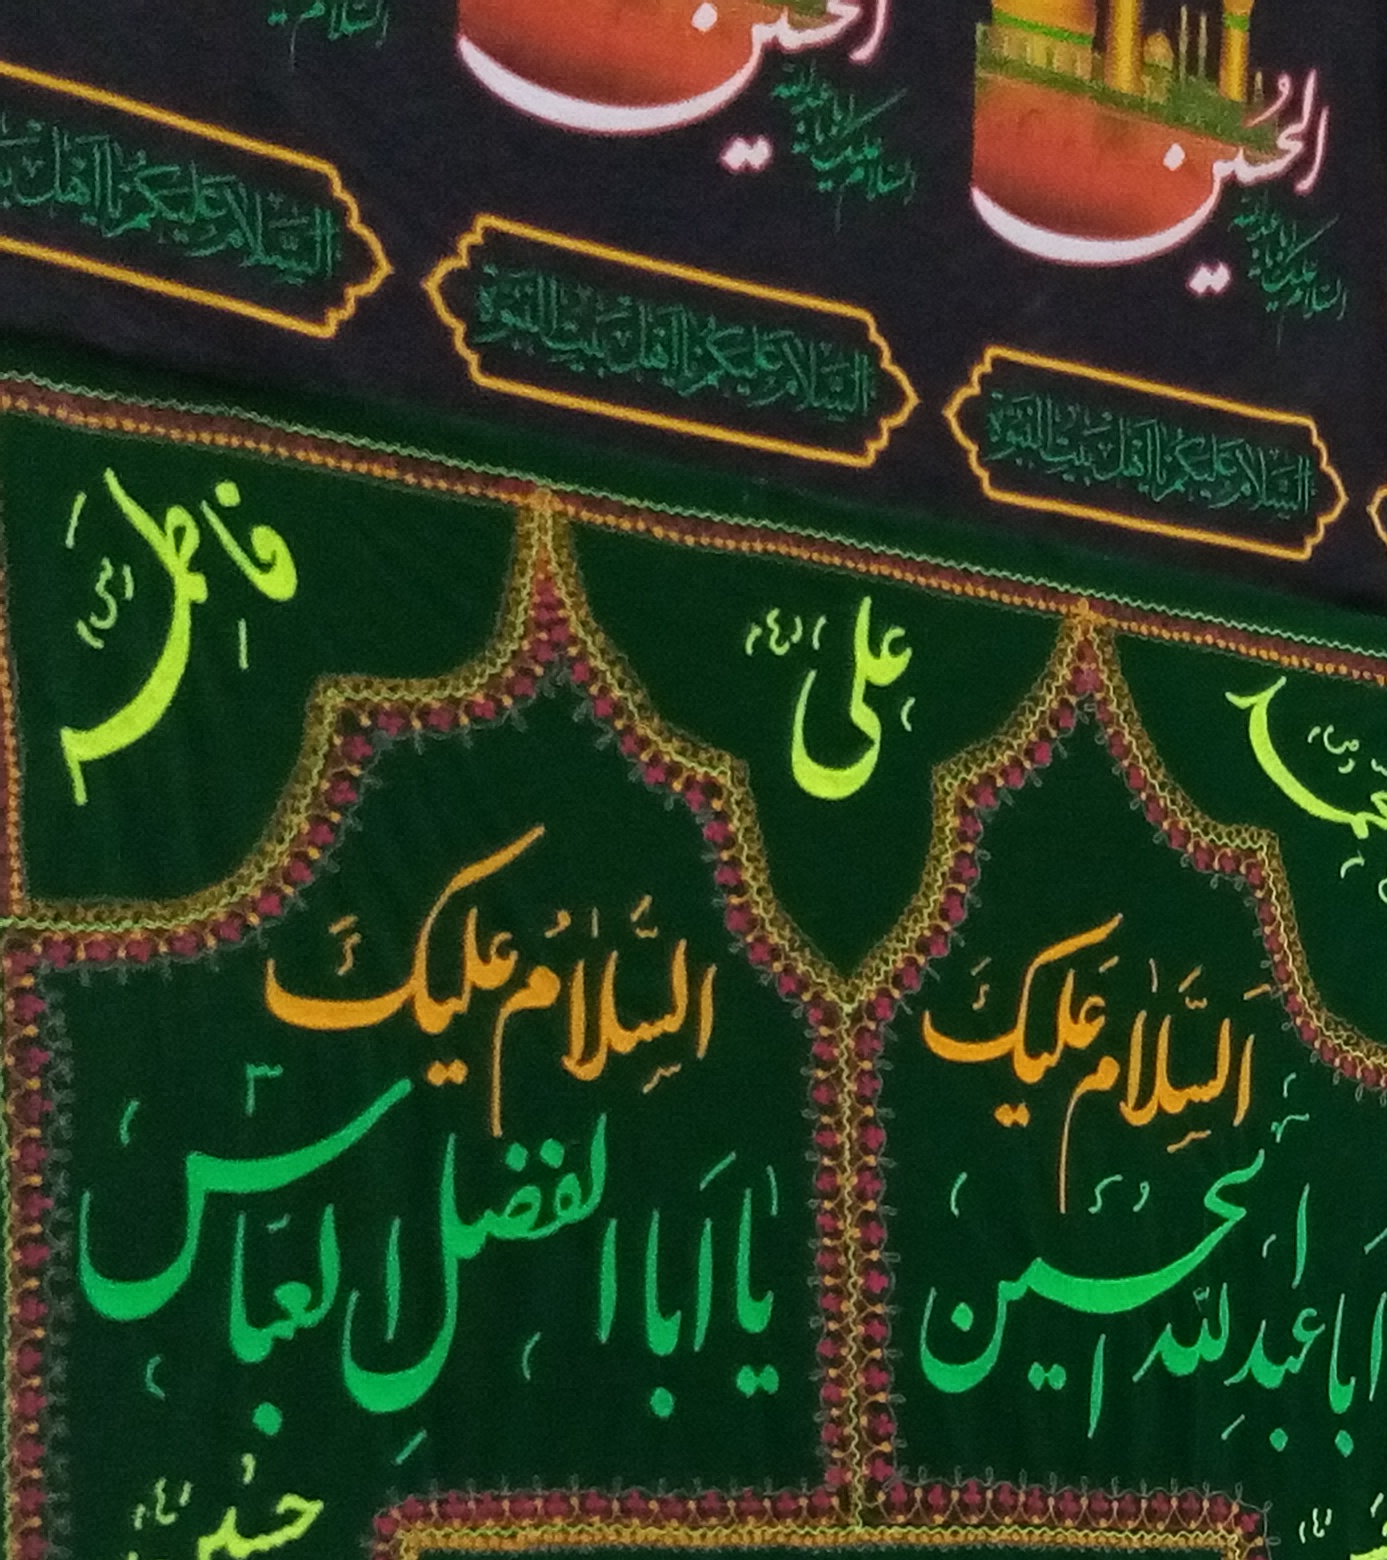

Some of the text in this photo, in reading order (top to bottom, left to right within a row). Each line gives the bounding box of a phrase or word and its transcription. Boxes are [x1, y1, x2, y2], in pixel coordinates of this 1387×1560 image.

[970, 68, 1331, 296] الحسين
[491, 915, 718, 1136] السلام
[1058, 985, 1256, 1213] السلام
